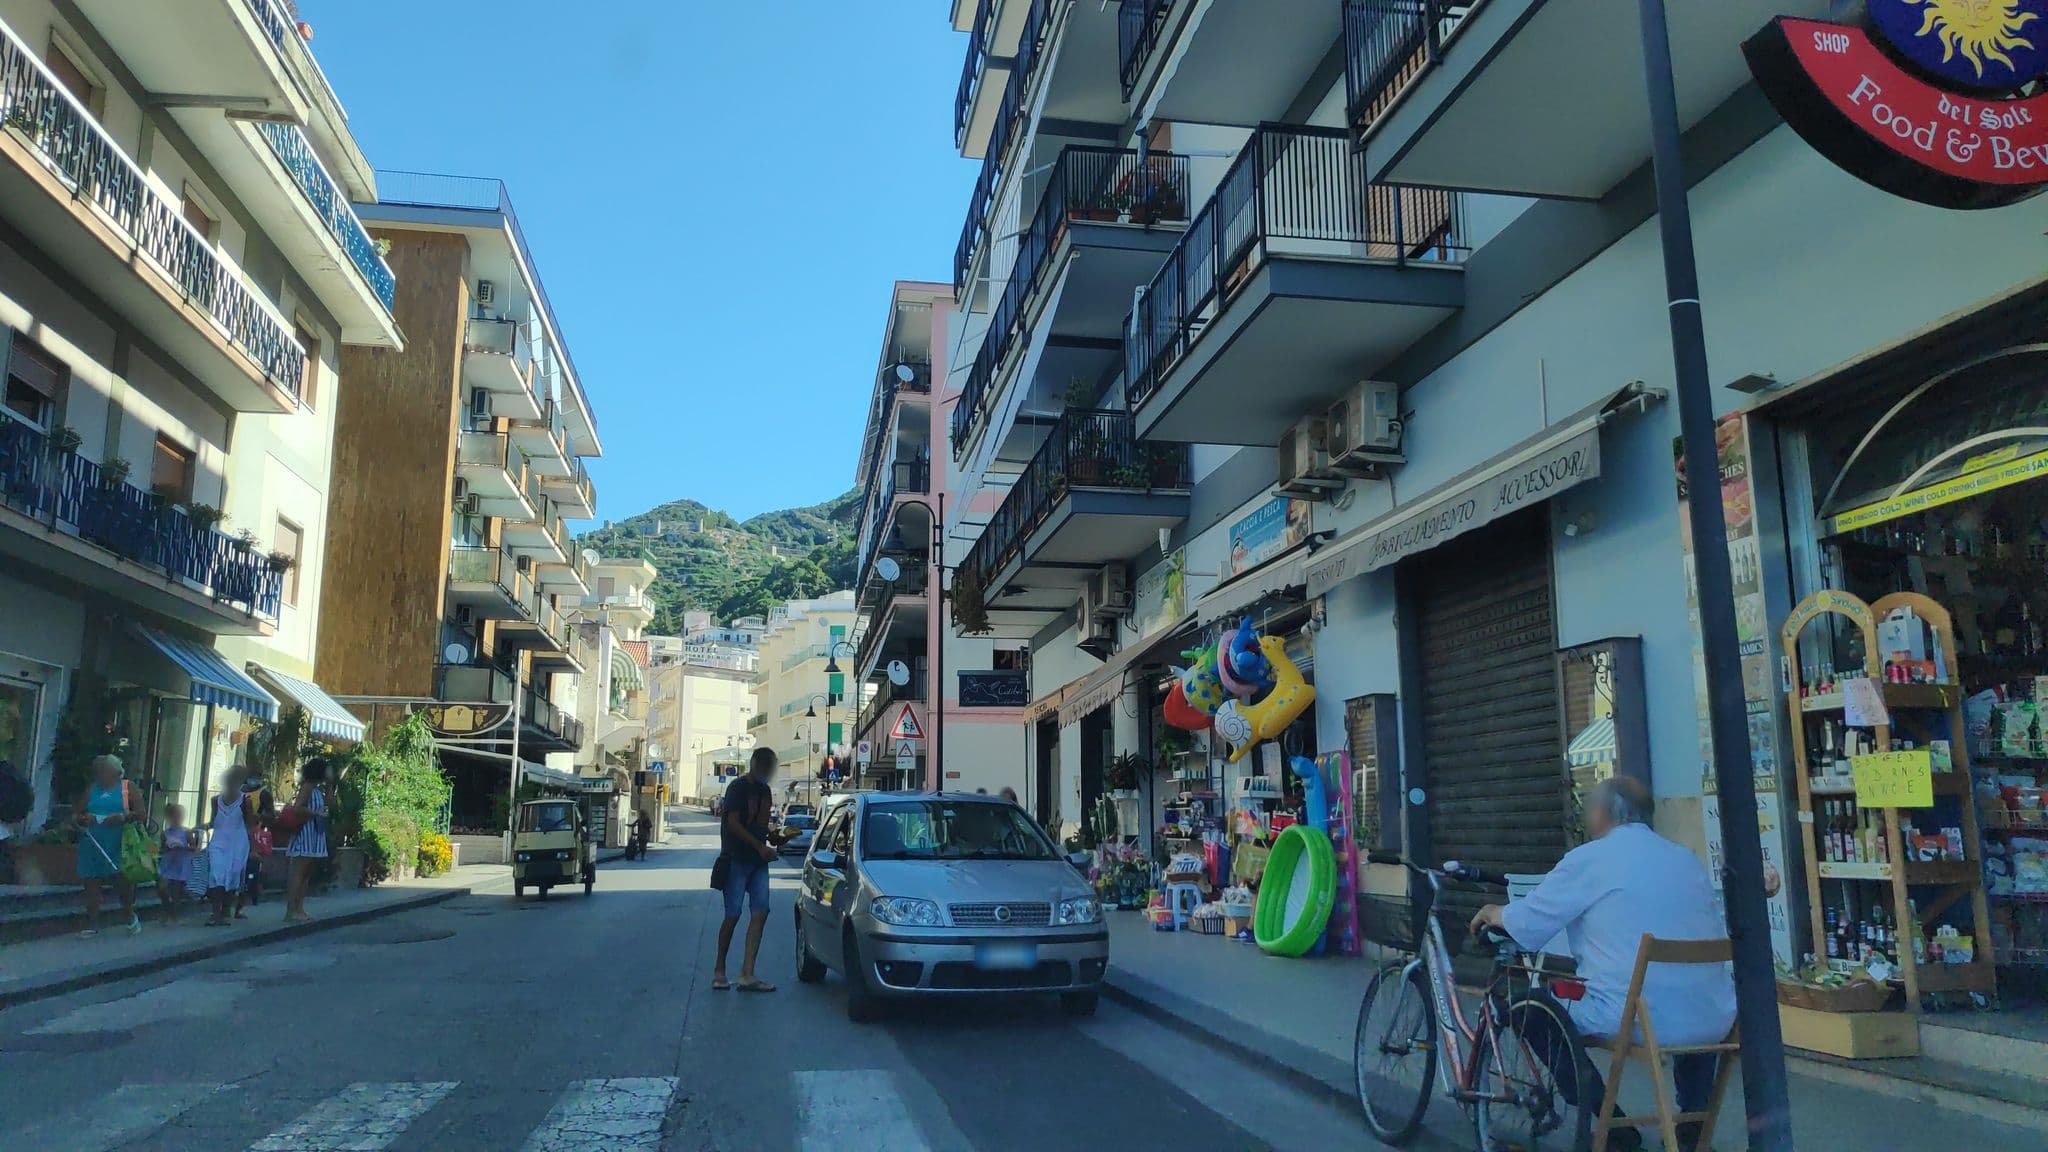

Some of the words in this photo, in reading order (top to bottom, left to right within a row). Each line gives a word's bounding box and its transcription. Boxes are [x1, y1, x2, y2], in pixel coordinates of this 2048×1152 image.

[1813, 31, 1850, 53] SHOP
[1847, 74, 1937, 151] Food
[1946, 129, 1981, 163] &
[1938, 94, 1972, 125] del
[1980, 105, 2033, 130] Sole
[1880, 503, 1902, 515] COLD
[1926, 489, 1947, 501] COLD
